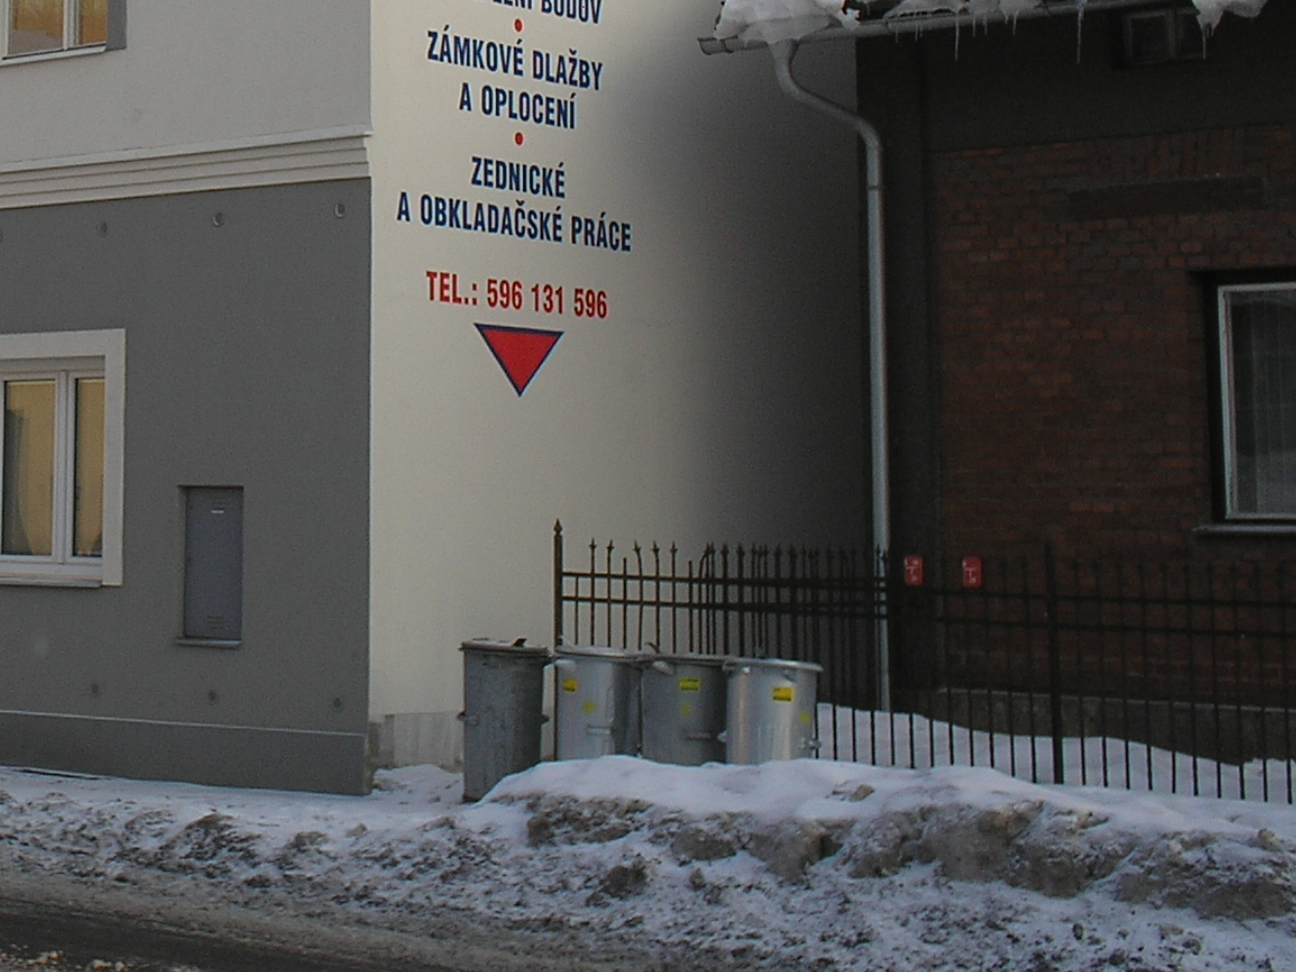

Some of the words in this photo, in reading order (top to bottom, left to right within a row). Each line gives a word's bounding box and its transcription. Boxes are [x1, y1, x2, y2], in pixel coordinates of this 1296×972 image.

[428, 25, 524, 77] ZÁMKOVÉ
[533, 49, 603, 91] DLAŽBY
[459, 83, 472, 112] A
[482, 85, 577, 130] OPLOCENÍ
[471, 156, 566, 199] ZEDNICKÉ
[397, 192, 411, 223] A
[421, 194, 563, 243] OBKLADAČSKÉ
[572, 212, 631, 252] PRÁCE
[426, 271, 478, 306] TEL.:
[487, 279, 523, 311] 596
[531, 284, 563, 315] 131
[574, 288, 607, 319] 596
